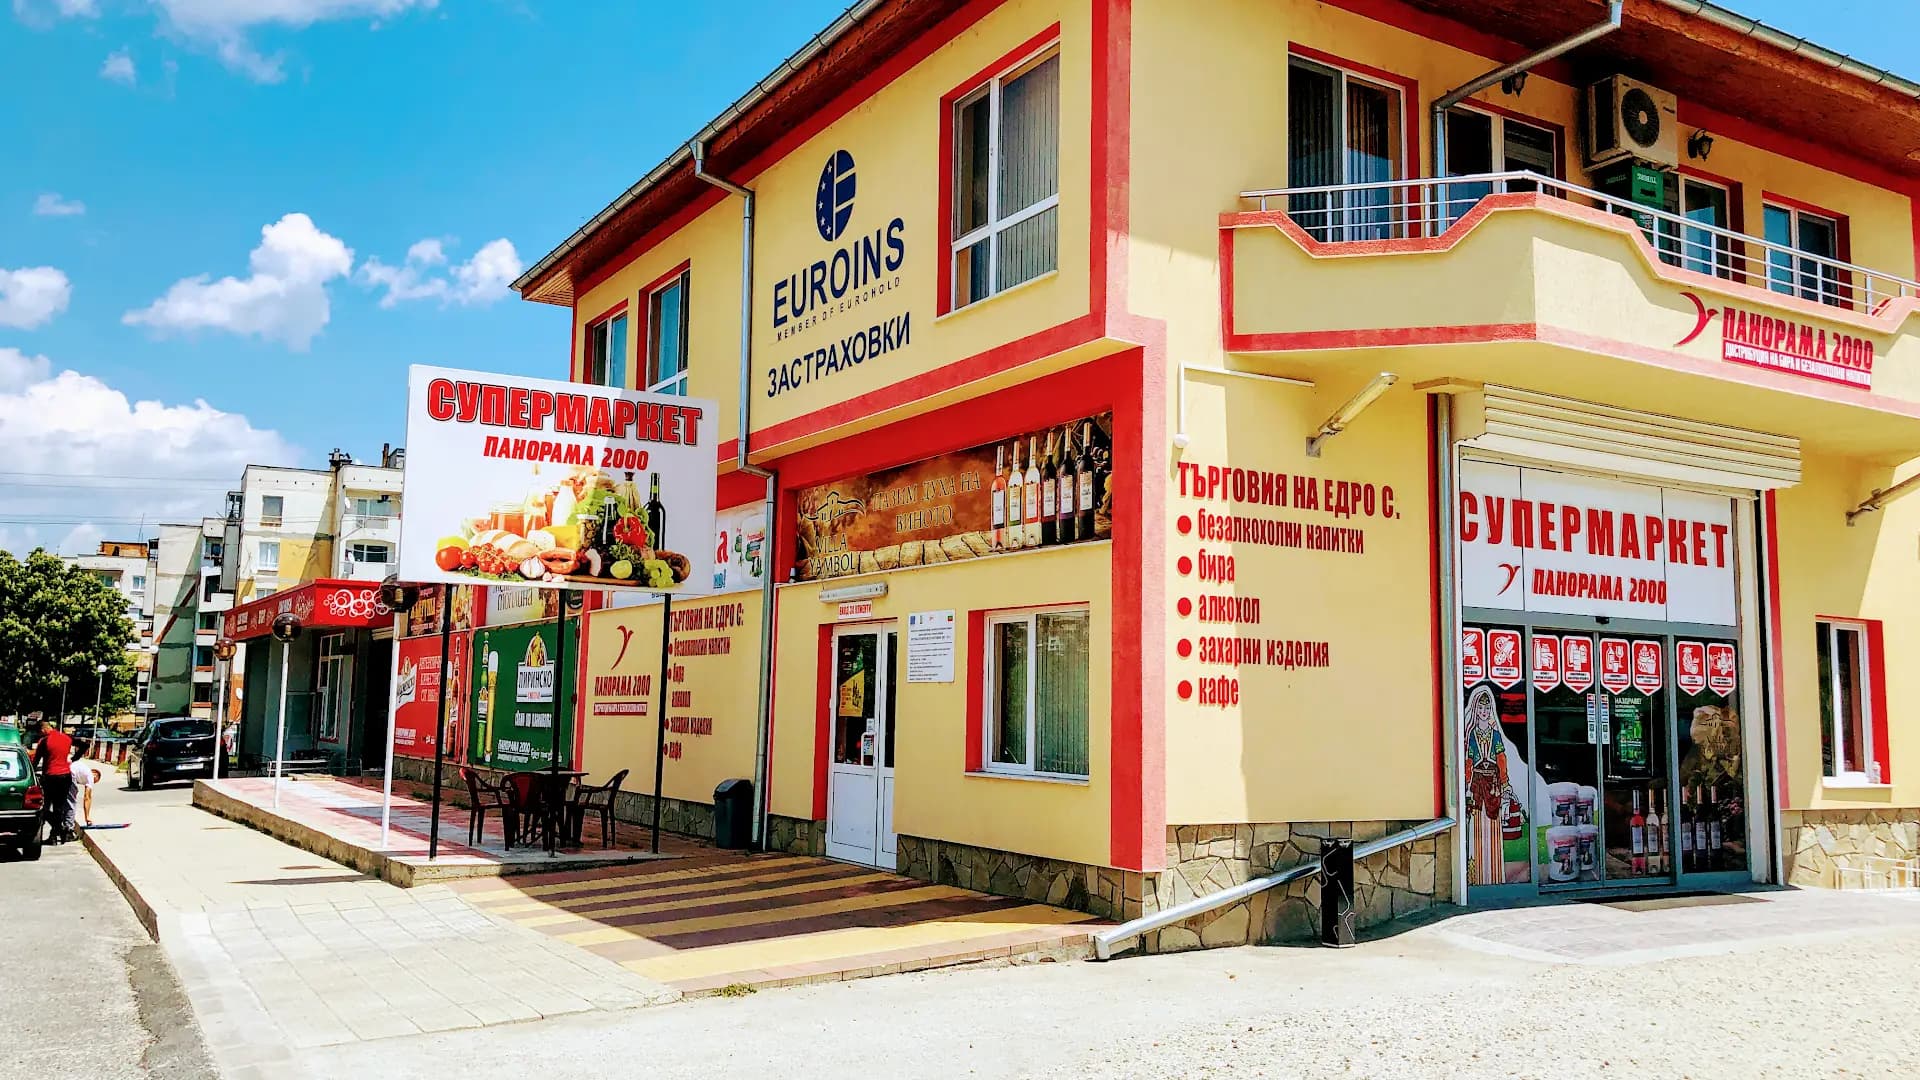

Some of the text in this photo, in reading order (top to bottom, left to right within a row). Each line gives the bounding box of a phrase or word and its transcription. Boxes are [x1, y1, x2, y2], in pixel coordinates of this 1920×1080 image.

[773, 217, 905, 329] EUROINS
[777, 276, 900, 342] MEMBER OF EUROHOLD
[767, 311, 910, 398] ЗАСТРАХОВКИ
[1722, 306, 1874, 370] ПАНОРАМА 2000
[427, 378, 702, 446] СУПЕРМАРКЕТ
[483, 435, 649, 471] ПАНОРАМА 2000
[960, 471, 981, 493] НА
[1177, 461, 1288, 508] ТЪРГОВИЯ
[1293, 475, 1319, 511] НА
[1324, 479, 1376, 520] ЕДРО
[896, 505, 953, 533] ВИНОТО
[1198, 508, 1364, 554] безалкохолни напитки
[1460, 491, 1728, 568] СУПЕРМАРКЕТ
[809, 551, 856, 577] YAMBOL
[1198, 548, 1235, 585] бира
[1533, 568, 1667, 605] ПАНОРАМА 2000
[670, 603, 744, 632] ТЪРГОВИЯ НА ЕДРО С:
[1199, 594, 1260, 624] алкохол
[1199, 636, 1330, 671] захарни изделия
[518, 670, 552, 689] ПИРИНСКО
[594, 675, 651, 697] ПАНОРАМА 2000
[1198, 675, 1239, 709] кафе
